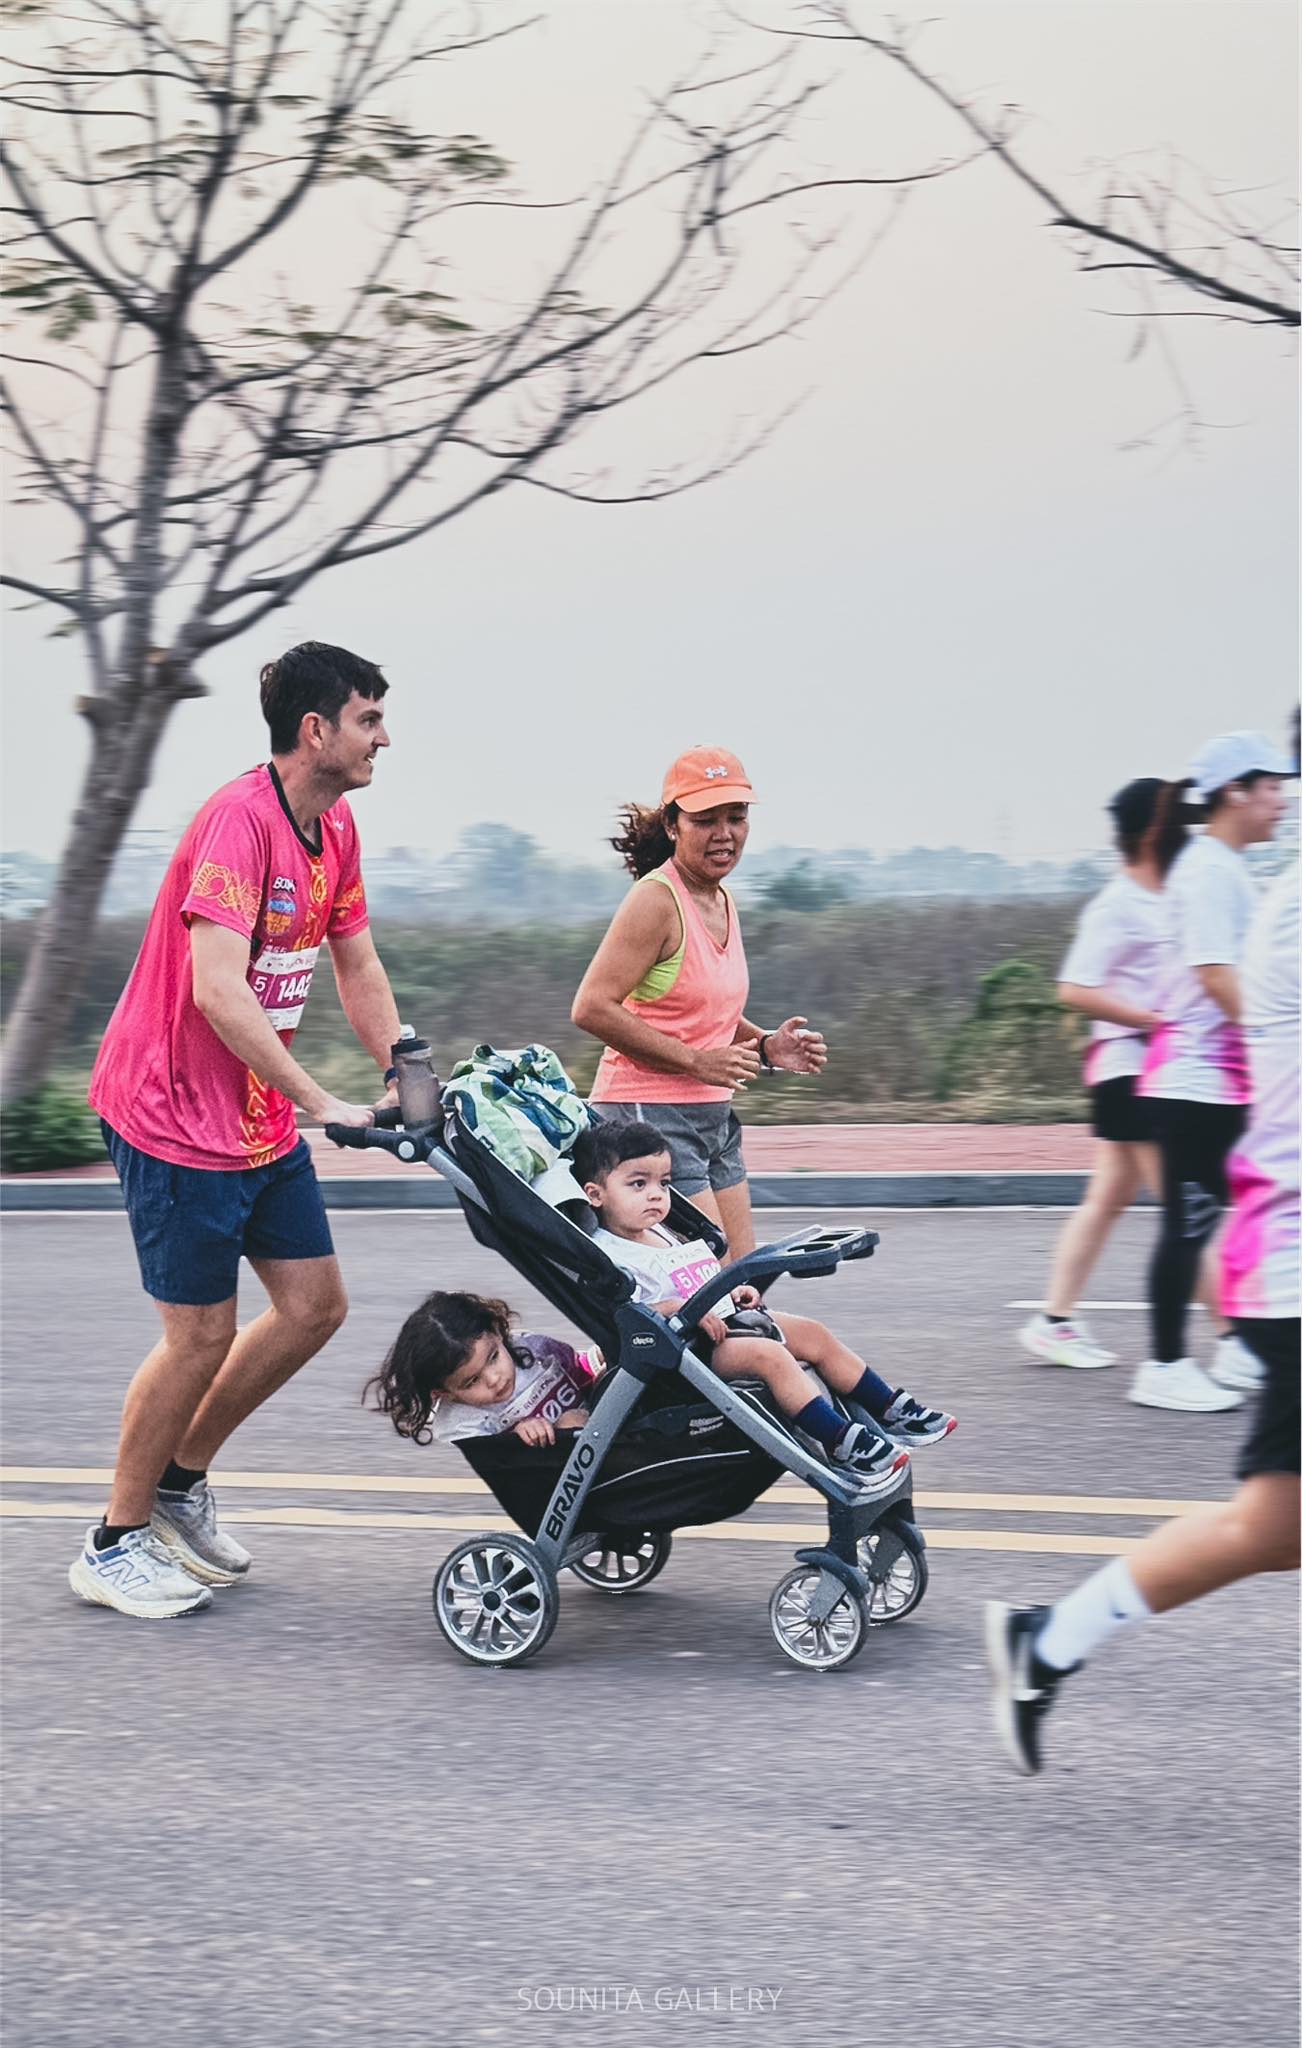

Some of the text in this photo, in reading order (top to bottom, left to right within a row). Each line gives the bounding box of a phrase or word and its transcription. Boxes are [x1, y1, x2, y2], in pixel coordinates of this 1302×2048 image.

[253, 975, 268, 992] 5
[675, 1271, 693, 1290] 5
[545, 1443, 595, 1542] BRAVO
